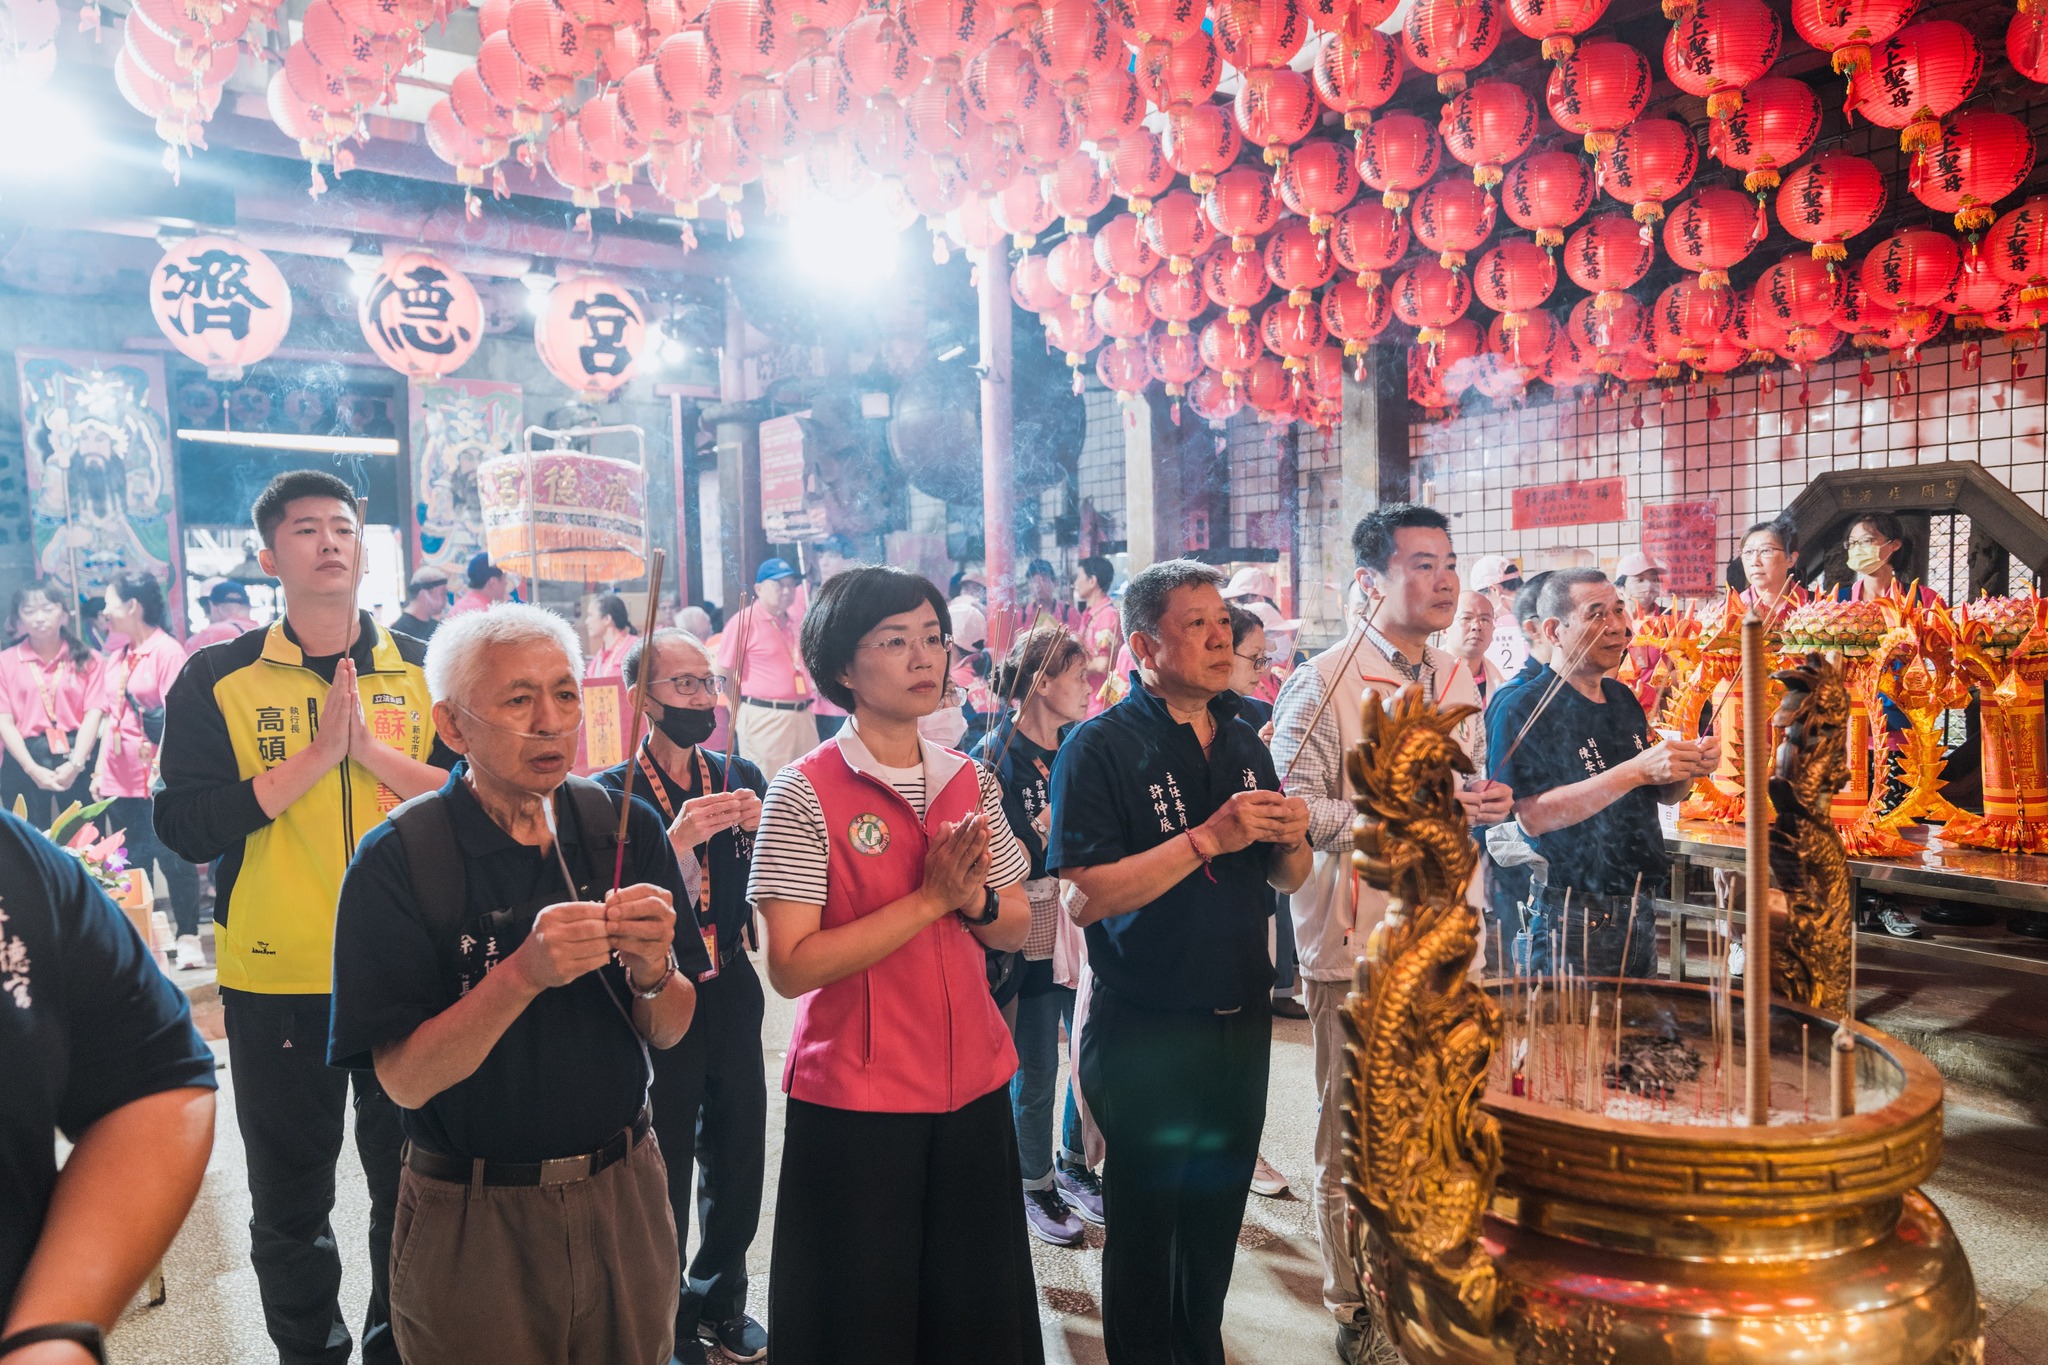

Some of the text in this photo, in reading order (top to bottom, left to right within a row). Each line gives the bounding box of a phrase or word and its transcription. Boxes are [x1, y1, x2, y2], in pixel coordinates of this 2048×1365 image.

[1687, 4, 1715, 76] 天上聖母
[1880, 36, 1914, 108] 天上聖母
[1456, 92, 1476, 149] 天上聖母
[1612, 126, 1634, 188] 天上聖母
[1935, 123, 1965, 193] 天上聖母
[1802, 163, 1825, 225] 天上聖母
[1581, 226, 1601, 280] 天上聖母
[1682, 196, 1705, 257] 天上聖母
[2007, 209, 2033, 273] 天上聖母
[1489, 251, 1508, 301] 天上聖母
[1769, 267, 1792, 319] 天上聖母
[1882, 237, 1904, 294] 天上聖母
[162, 249, 641, 375] 濟 德 宮
[1844, 270, 1861, 322] 天上聖母
[1501, 649, 1514, 670] 2
[255, 706, 288, 771] 高碩
[289, 706, 301, 734] 執行長
[374, 708, 407, 812] 蘇慧
[1587, 737, 1607, 772] 副主任
[1148, 784, 1176, 833] 許仲辰
[1166, 772, 1188, 827] 主任委員
